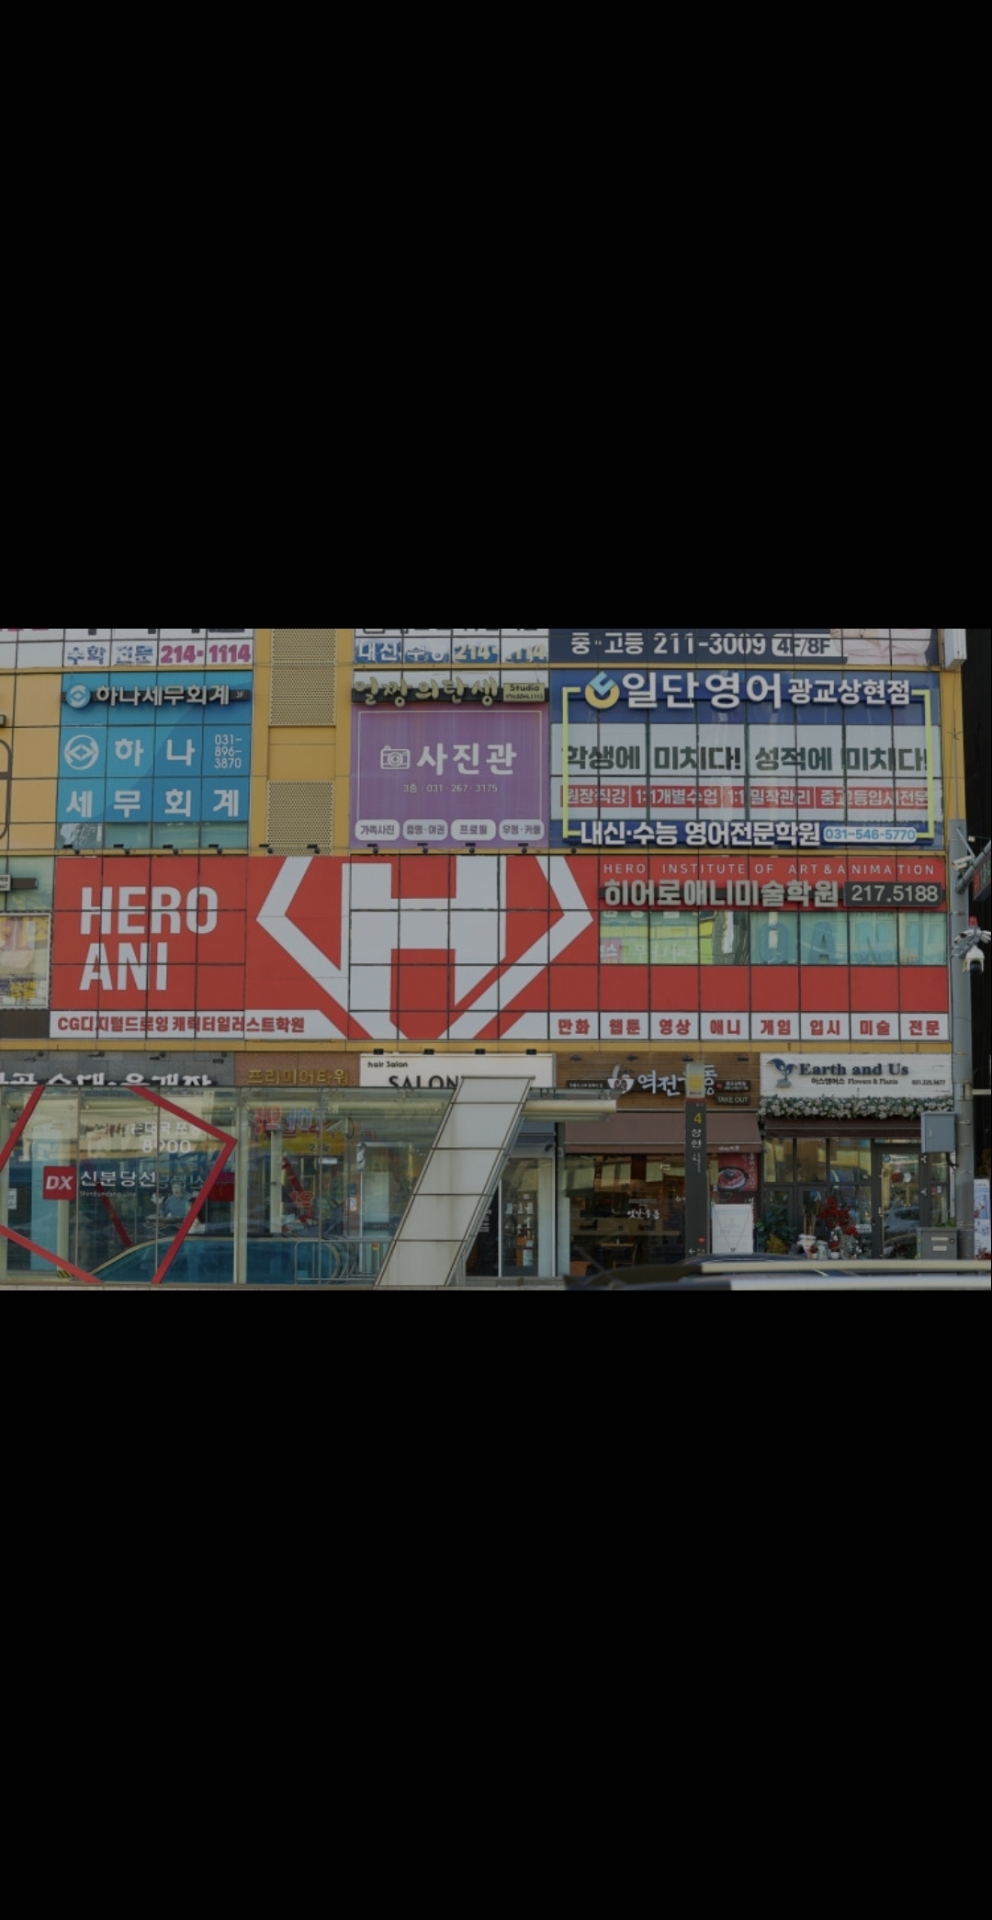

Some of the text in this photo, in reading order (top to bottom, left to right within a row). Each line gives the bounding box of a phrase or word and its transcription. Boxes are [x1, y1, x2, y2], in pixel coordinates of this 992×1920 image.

[653, 632, 766, 655] 211-3009
[776, 636, 831, 655] 4F/8F
[96, 685, 229, 706] 하나세무회계
[622, 672, 910, 709] 일단영어 광교상현점
[214, 757, 242, 769] 3870
[416, 742, 518, 776] 사진관
[562, 746, 928, 771] 학생에 미치다! 성적에 미치다!
[66, 788, 240, 819] 세무회계
[566, 788, 626, 805] 원장직강
[751, 788, 811, 805] 밀착관리
[820, 788, 929, 806] 중고등입시전문
[360, 824, 395, 836] 가족사진
[460, 824, 488, 835] 프로필
[581, 821, 821, 847] 내신·수능 영어전문학원
[825, 829, 916, 841] 031-546-5770
[604, 863, 646, 875] HERO
[662, 863, 745, 875] INSTITUTE
[755, 863, 774, 874] OF
[605, 879, 839, 908] 히어로애니미술학원
[850, 884, 939, 904] 217.5188
[80, 886, 219, 935] HERO
[79, 942, 169, 991] ANI
[57, 1015, 305, 1033] CG디지털드로잉 캐릭터일러스트학원
[557, 1019, 940, 1035] 만화 웹툰 영상 애니 게임 입시 미술 전문
[247, 1068, 350, 1085] 프리미어타워
[799, 1063, 909, 1076] Earth and Us
[693, 1112, 702, 1124] 4
[45, 1175, 74, 1190] DX
[79, 1170, 156, 1187] 신분당선
